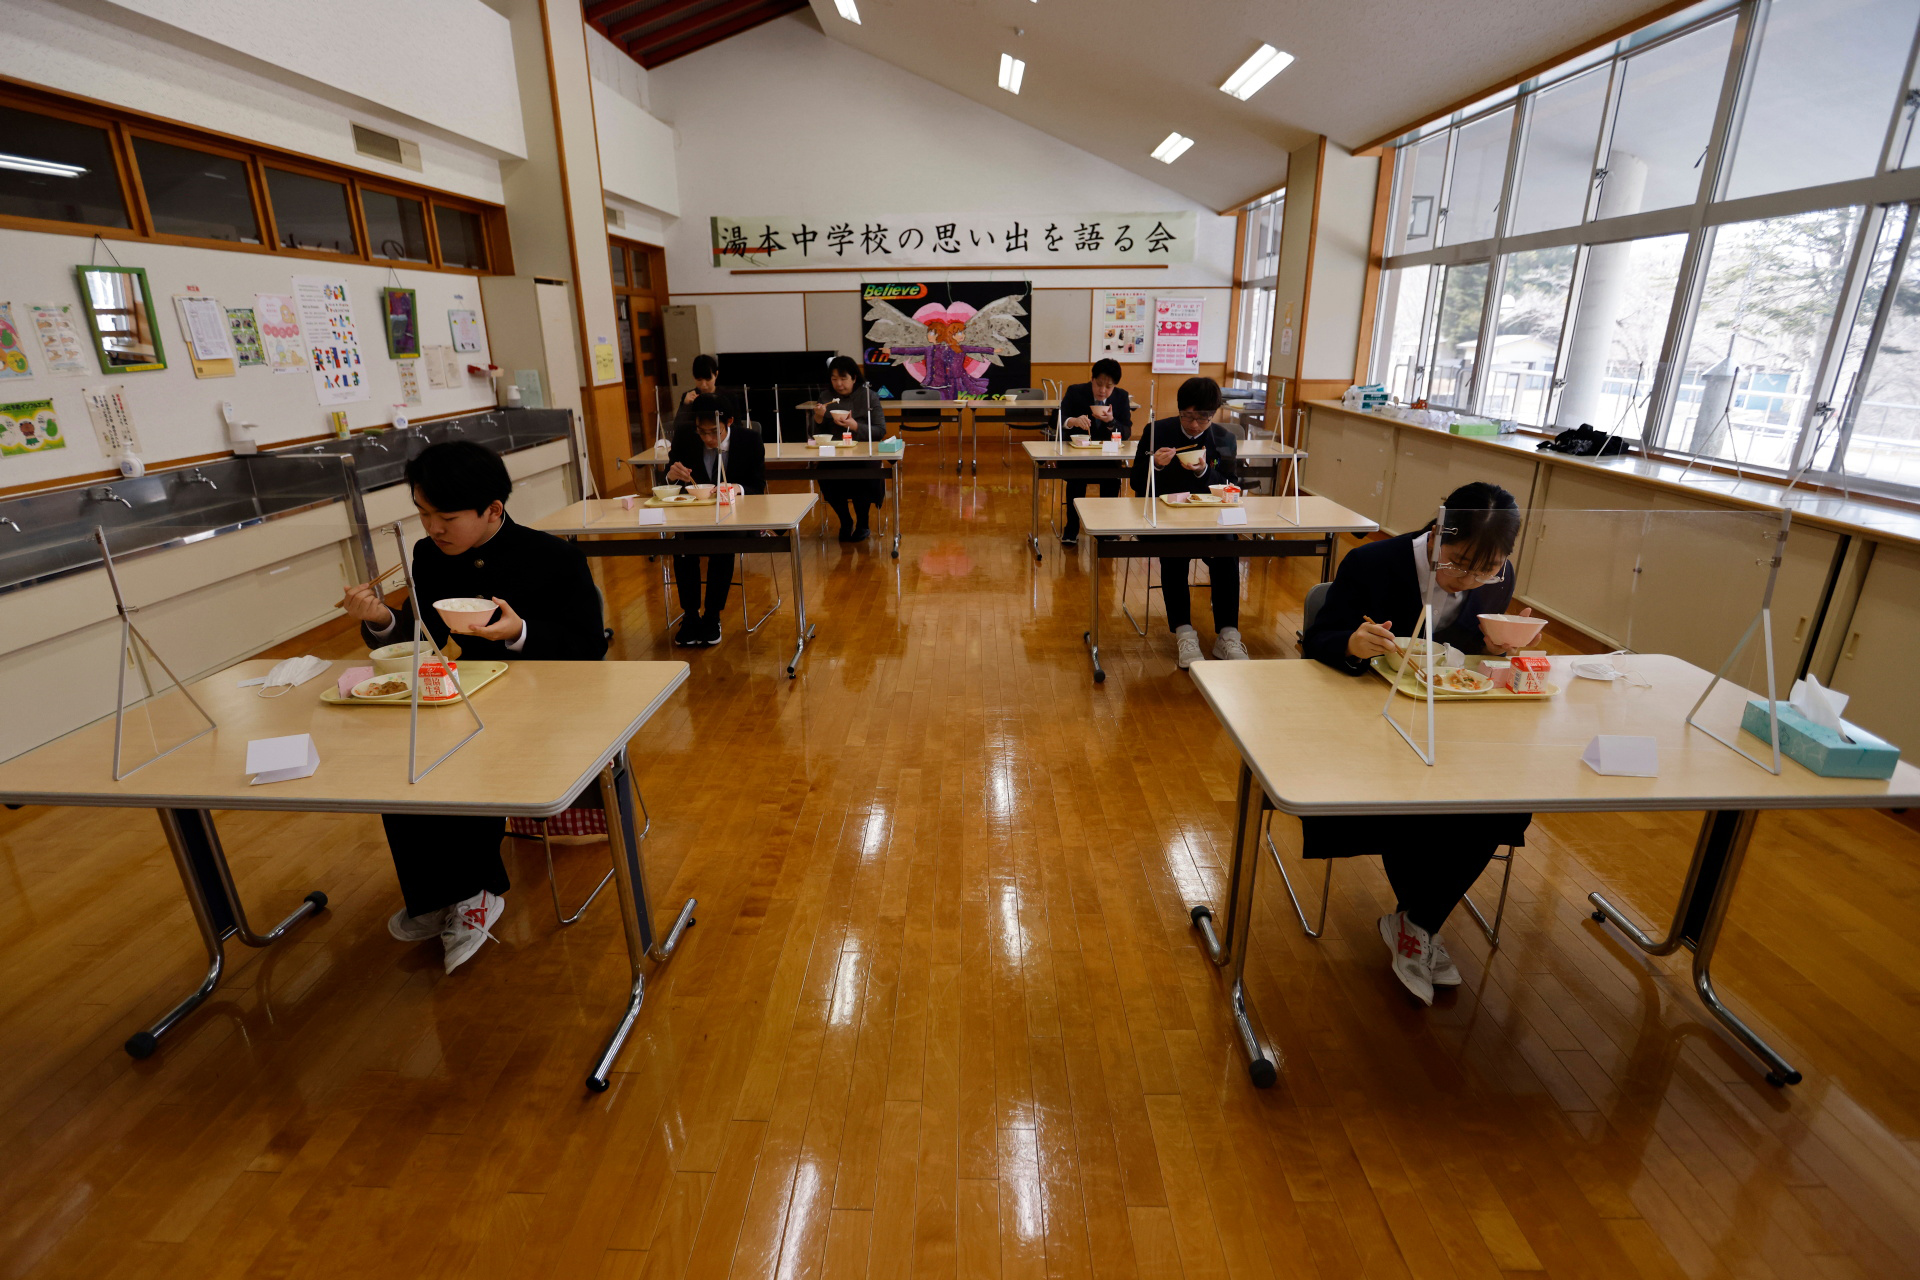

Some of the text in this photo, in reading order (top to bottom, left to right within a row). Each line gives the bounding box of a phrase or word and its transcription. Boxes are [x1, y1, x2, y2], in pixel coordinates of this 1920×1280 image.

[721, 221, 1177, 258] 湯本中学校の思い出を語る会
[864, 284, 920, 297] Believe
[870, 350, 891, 363] in
[323, 371, 361, 389] ふくしま
[425, 686, 443, 695] 牛乳
